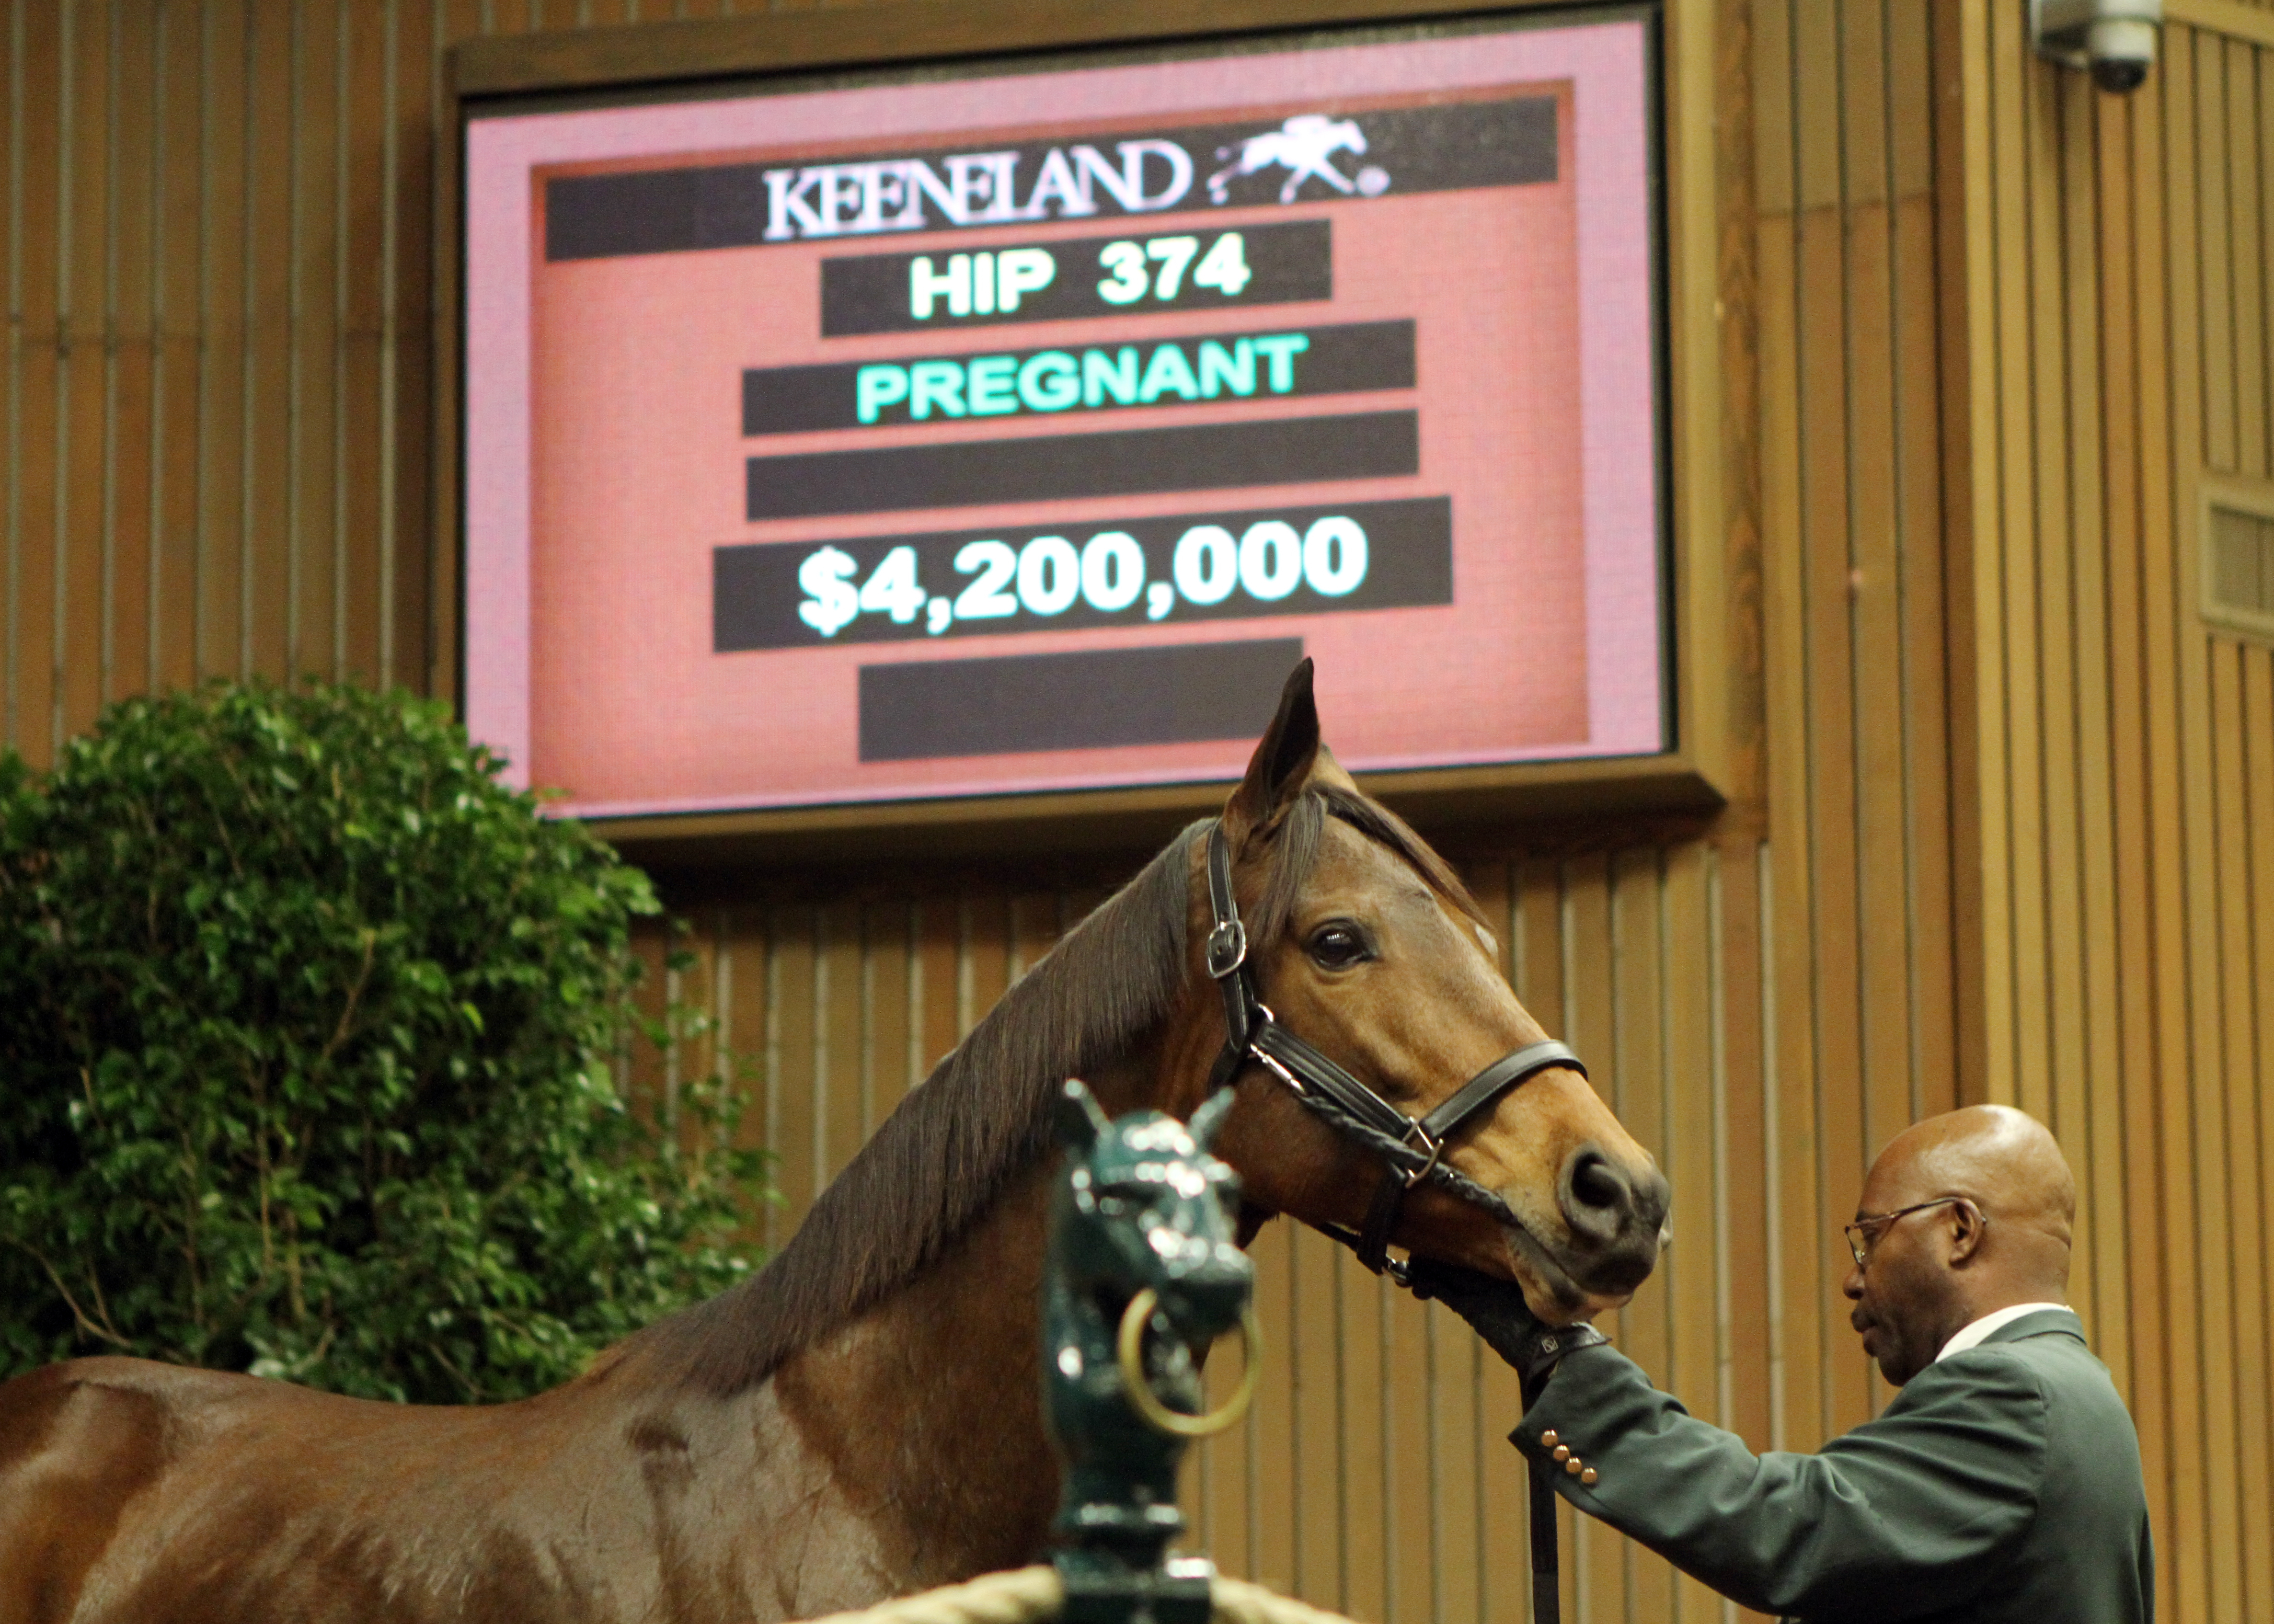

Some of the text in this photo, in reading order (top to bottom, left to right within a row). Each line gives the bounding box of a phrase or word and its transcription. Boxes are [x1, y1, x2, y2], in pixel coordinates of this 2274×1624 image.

[763, 139, 1194, 241] KEENELAND
[909, 232, 1252, 320] HIP 374
[856, 333, 1310, 423] PREGNANT
[797, 515, 1369, 638] $4,200,000
